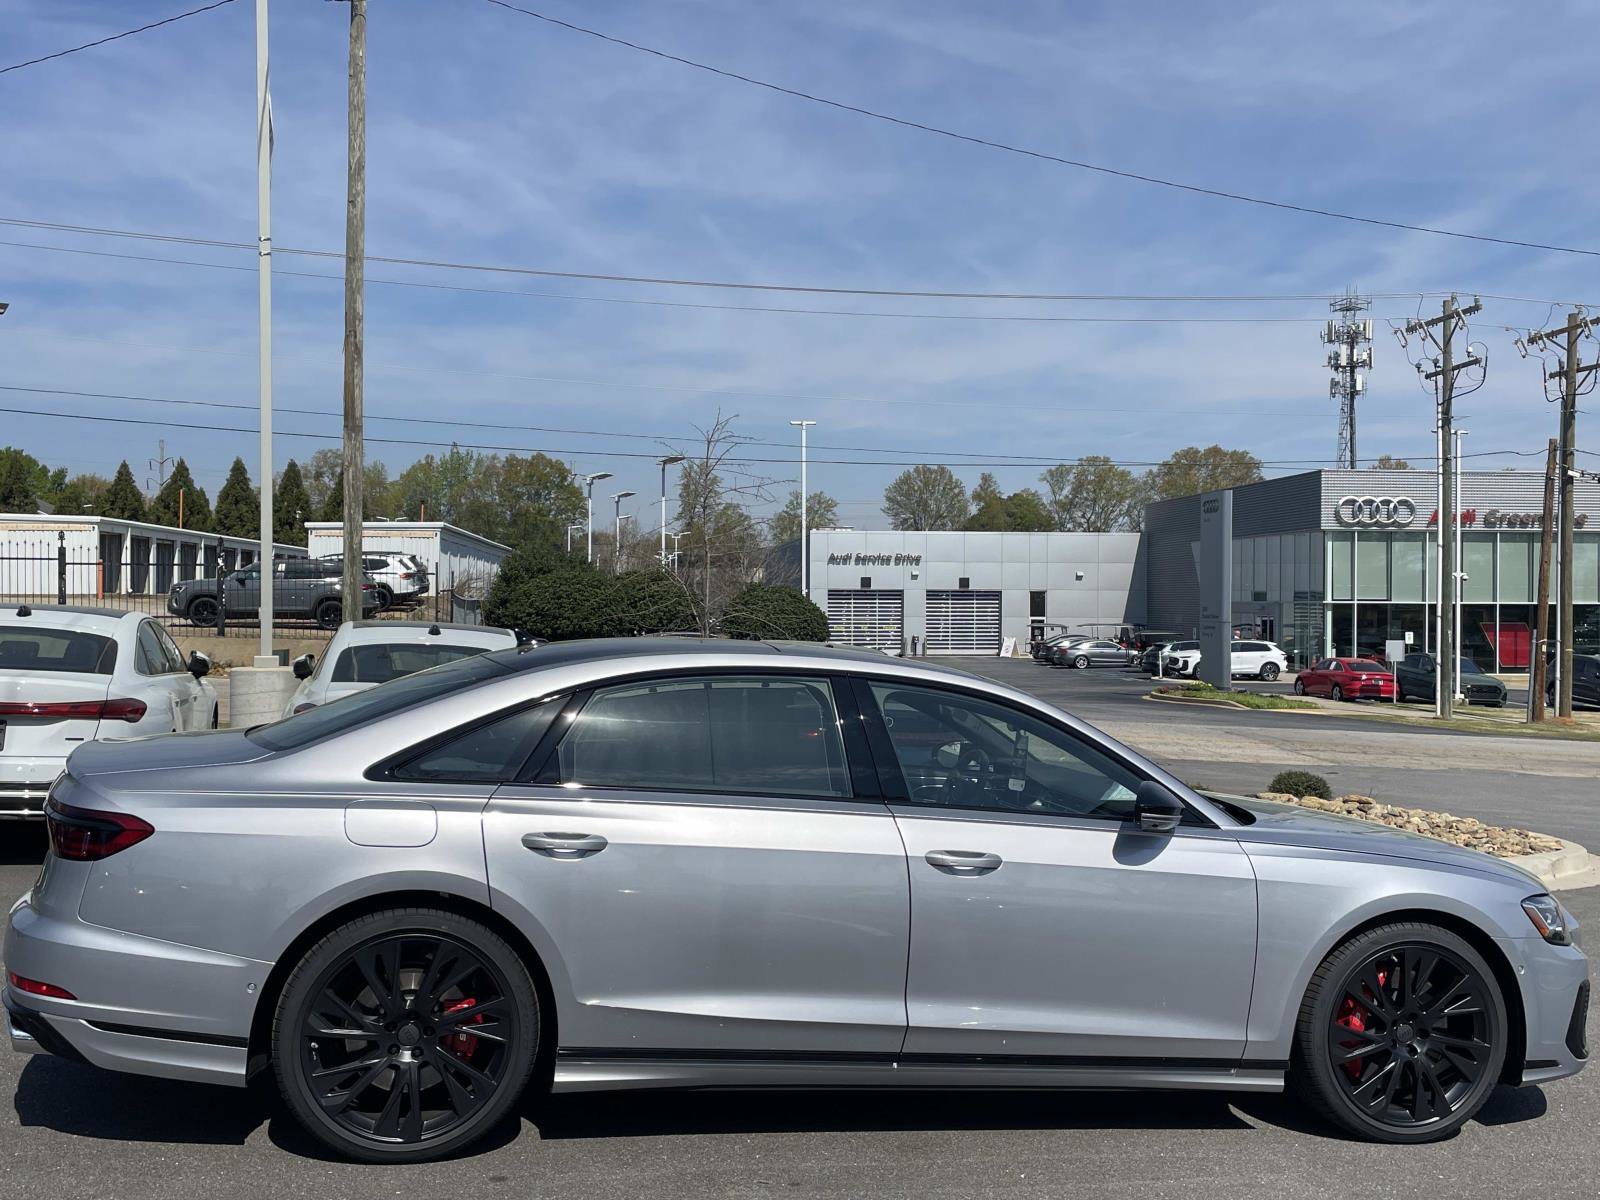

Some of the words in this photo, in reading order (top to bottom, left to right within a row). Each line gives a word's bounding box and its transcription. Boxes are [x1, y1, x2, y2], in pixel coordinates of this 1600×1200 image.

[1485, 508, 1588, 528] Greene
[827, 552, 852, 565] Audi
[855, 552, 892, 566] Service
[894, 553, 922, 566] Drive
